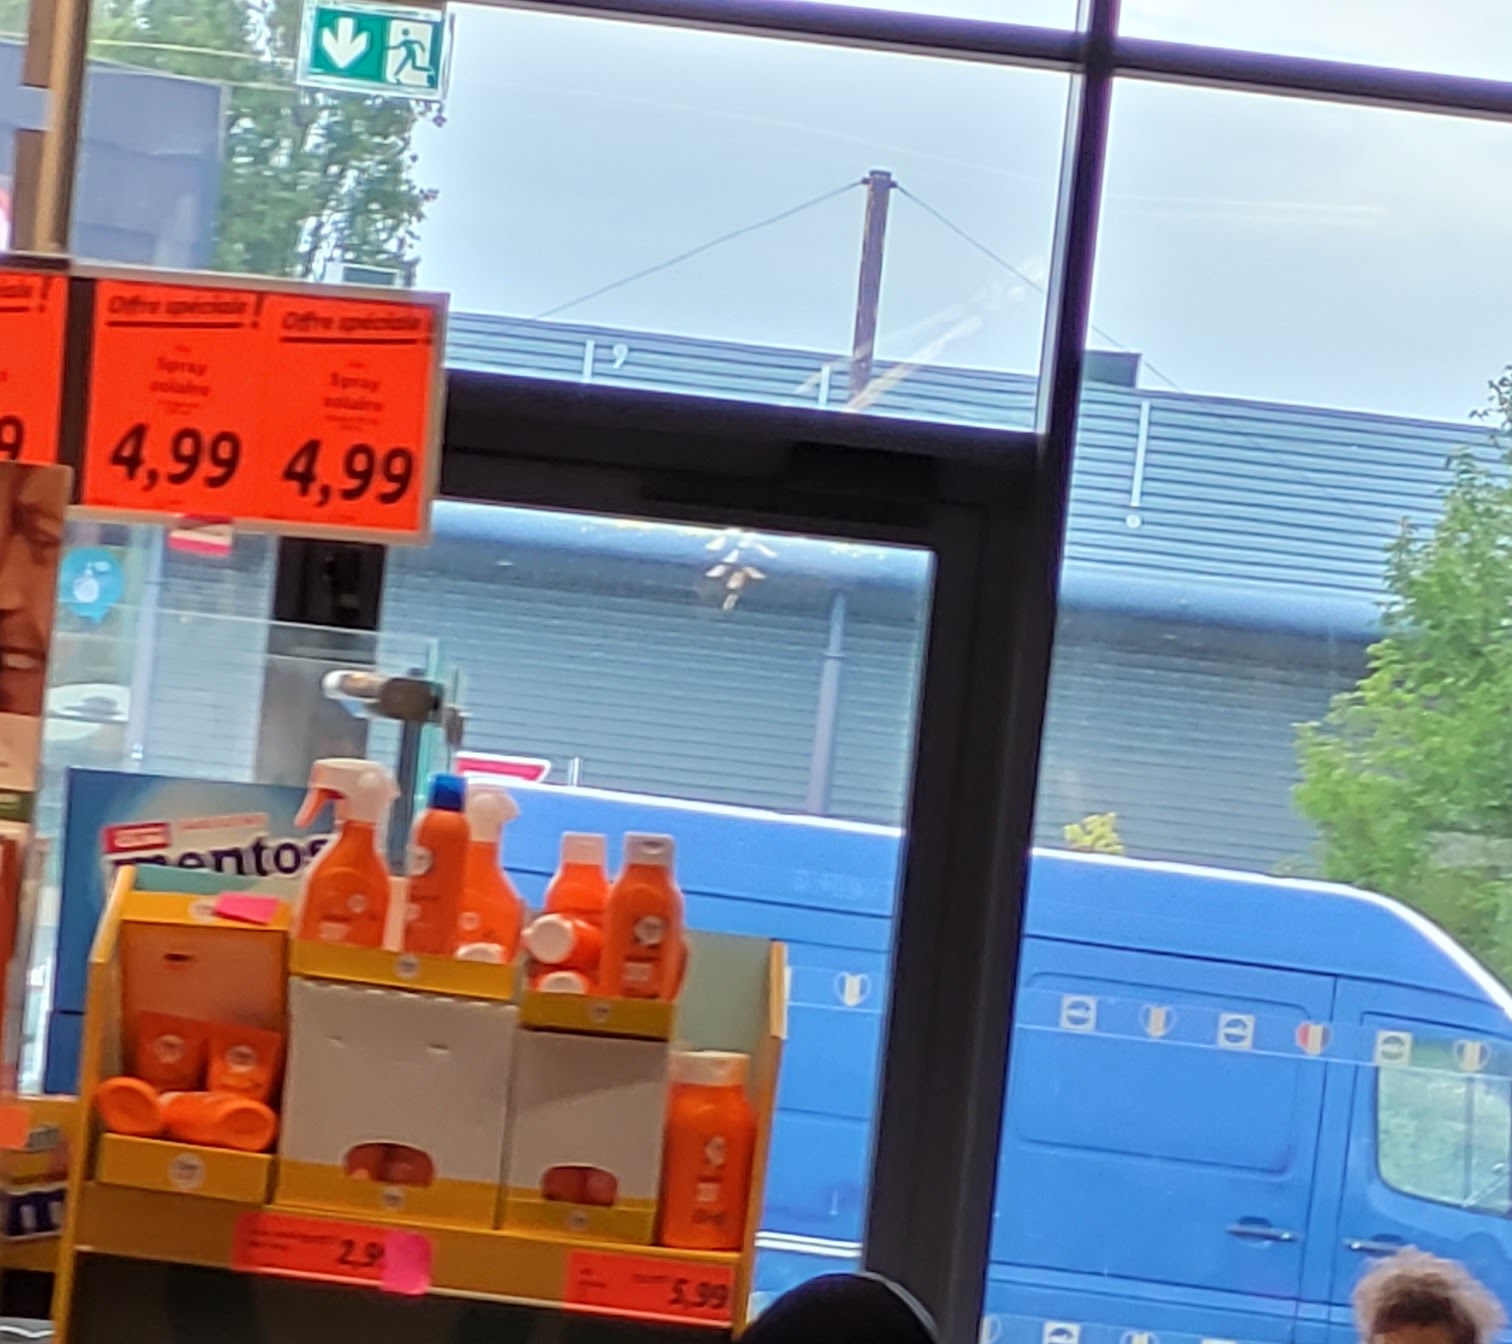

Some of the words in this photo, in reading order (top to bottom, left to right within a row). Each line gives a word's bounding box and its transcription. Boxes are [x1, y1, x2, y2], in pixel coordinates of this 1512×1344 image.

[156, 356, 207, 376] Spray
[329, 371, 381, 392] Spray
[109, 421, 243, 492] 4,99
[281, 438, 414, 508] 4,99
